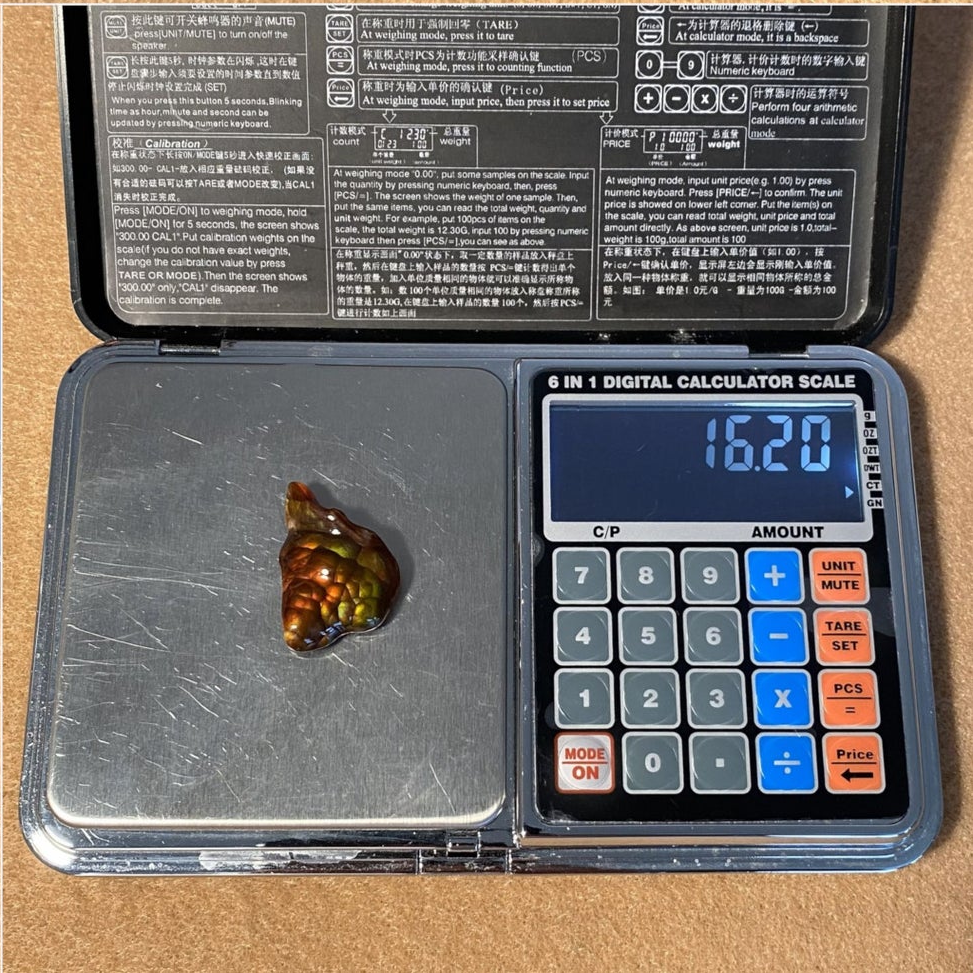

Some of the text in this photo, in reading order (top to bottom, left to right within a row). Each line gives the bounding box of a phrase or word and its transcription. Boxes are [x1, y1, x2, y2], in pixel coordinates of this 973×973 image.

[360, 30, 372, 40] At
[374, 30, 417, 41] weighing
[420, 31, 447, 41] mode,
[450, 33, 474, 42] press
[476, 30, 483, 40] it
[675, 32, 838, 44] At calculator mode, it is a backspace
[572, 50, 607, 64] (PCS)
[366, 61, 377, 70] At
[380, 61, 420, 72] weighing
[422, 61, 449, 71] mode,
[452, 64, 474, 73] press
[477, 62, 483, 71] it
[497, 63, 534, 73] counting
[537, 62, 572, 71] function
[646, 60, 694, 70] 0 9
[710, 67, 795, 77] Numeric keyboard
[500, 85, 543, 96] (Price)
[362, 95, 374, 104] At
[376, 96, 418, 107] weighing
[420, 96, 448, 106] mode,
[451, 96, 474, 108] input
[477, 96, 502, 108] price,
[505, 96, 524, 105] then
[527, 99, 550, 108] press
[553, 97, 559, 106] it
[562, 98, 570, 106] to
[587, 97, 609, 109] price
[751, 102, 857, 112] Perform four arithmetic
[751, 115, 864, 126] calculations at calculator
[751, 128, 775, 137] mode
[333, 137, 471, 146] count weight
[708, 140, 740, 149] weight
[604, 235, 746, 245] weight is 100g,total amount is 100
[119, 295, 223, 306] calibration is complete.
[548, 375, 856, 389] 6 IN 1 DIGITAL CALCULATOR SCALE
[863, 429, 874, 437] OZ
[705, 415, 830, 471] 16.20
[593, 526, 824, 538] C/P AMOUNT
[822, 561, 856, 571] UNIT
[574, 566, 718, 584] 7 8 9
[822, 581, 860, 590] MUTE
[826, 622, 862, 631] TARE
[575, 627, 721, 645] 4 5 6
[832, 641, 858, 651] SET
[834, 683, 863, 694] PCS
[579, 689, 725, 708] 1 2 3
[565, 748, 605, 760] MODE
[837, 749, 873, 760] Price
[645, 753, 661, 772] 0
[572, 766, 599, 780] ON
